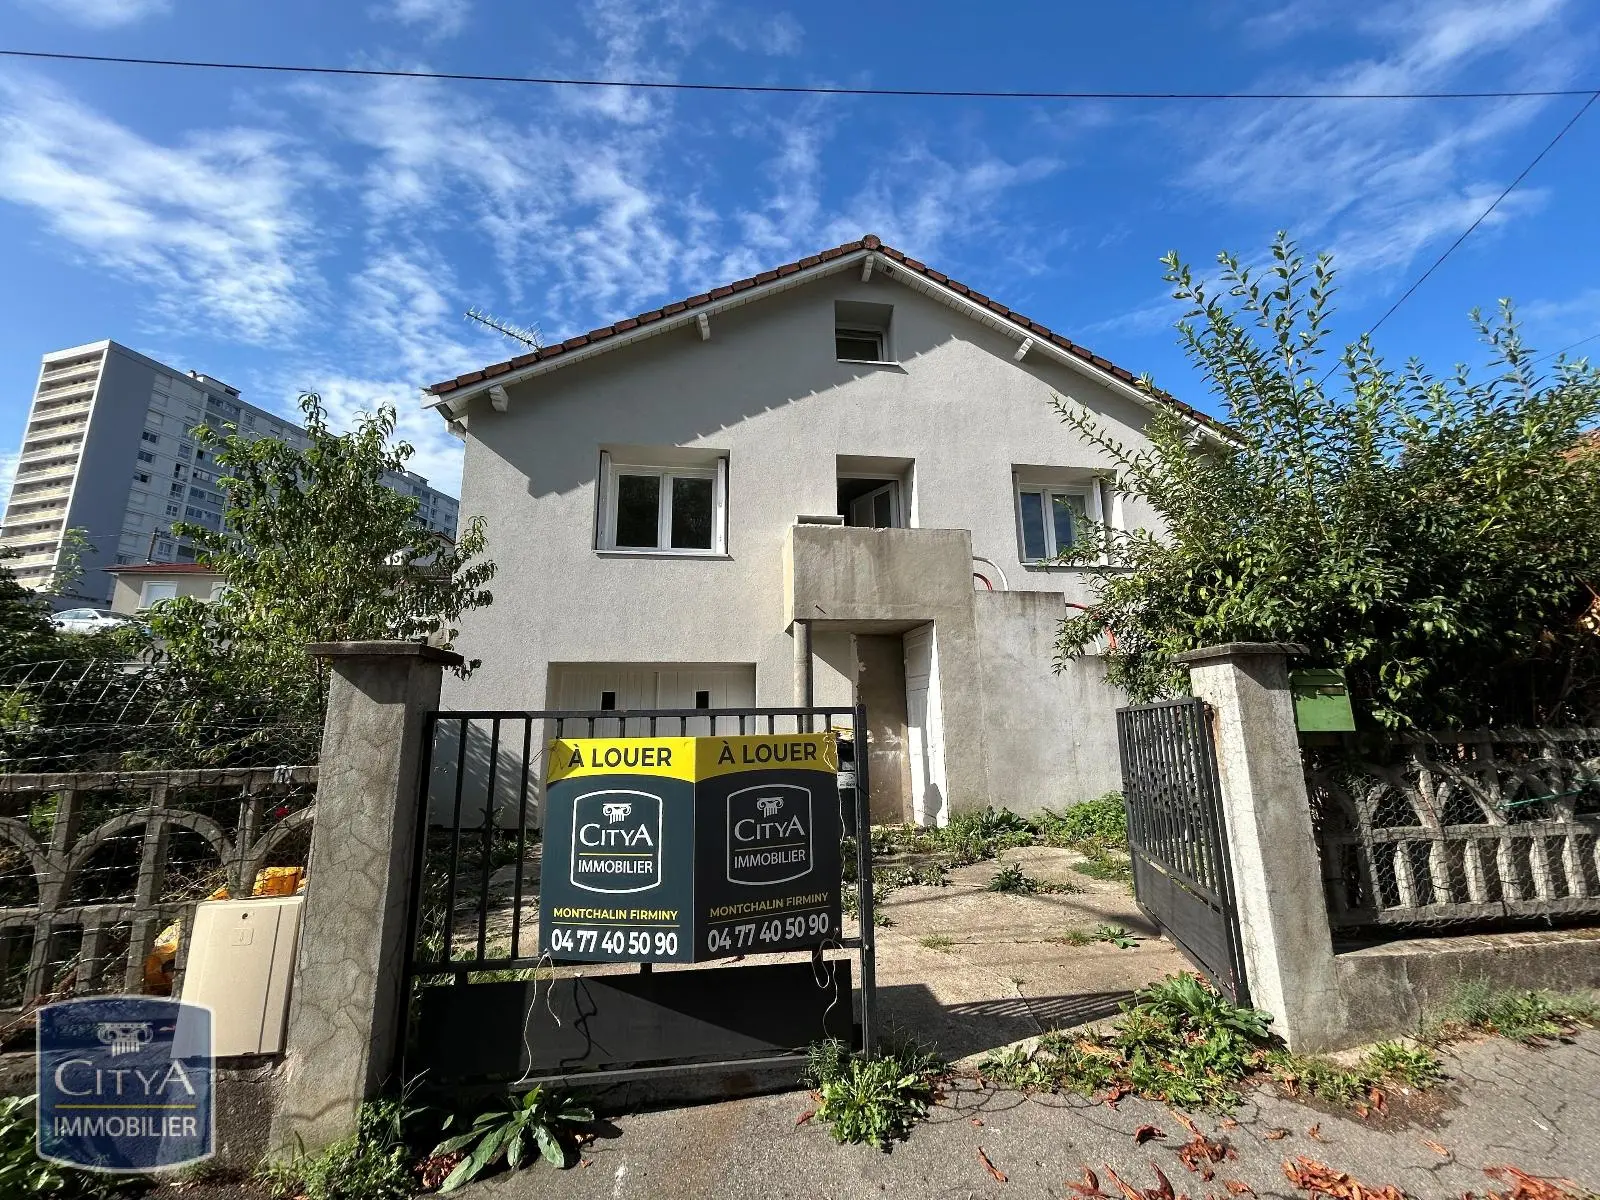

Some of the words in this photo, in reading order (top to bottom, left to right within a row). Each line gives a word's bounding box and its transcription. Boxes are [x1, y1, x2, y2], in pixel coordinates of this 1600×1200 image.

[568, 745, 584, 768] À
[592, 748, 672, 768] LOUER
[718, 741, 735, 765] À
[743, 743, 817, 764] LOUER
[579, 824, 654, 847] CITYA
[734, 815, 805, 841] CITYA
[578, 860, 653, 874] IMMOBILIER
[735, 849, 805, 869] IMMOBILIER
[553, 908, 627, 920] MONTCHALIN
[630, 910, 678, 921] FIRMINY
[710, 899, 784, 917] MONTCHALIN
[786, 892, 829, 907] FIRMINY
[551, 928, 574, 952] 04
[576, 930, 597, 953] 77
[601, 931, 625, 954] 40
[628, 932, 651, 955] 50
[655, 932, 678, 956] 90
[707, 927, 732, 952] 04
[734, 924, 756, 947] 77
[759, 919, 781, 943] 40
[784, 915, 805, 938] 50
[809, 912, 829, 934] 90
